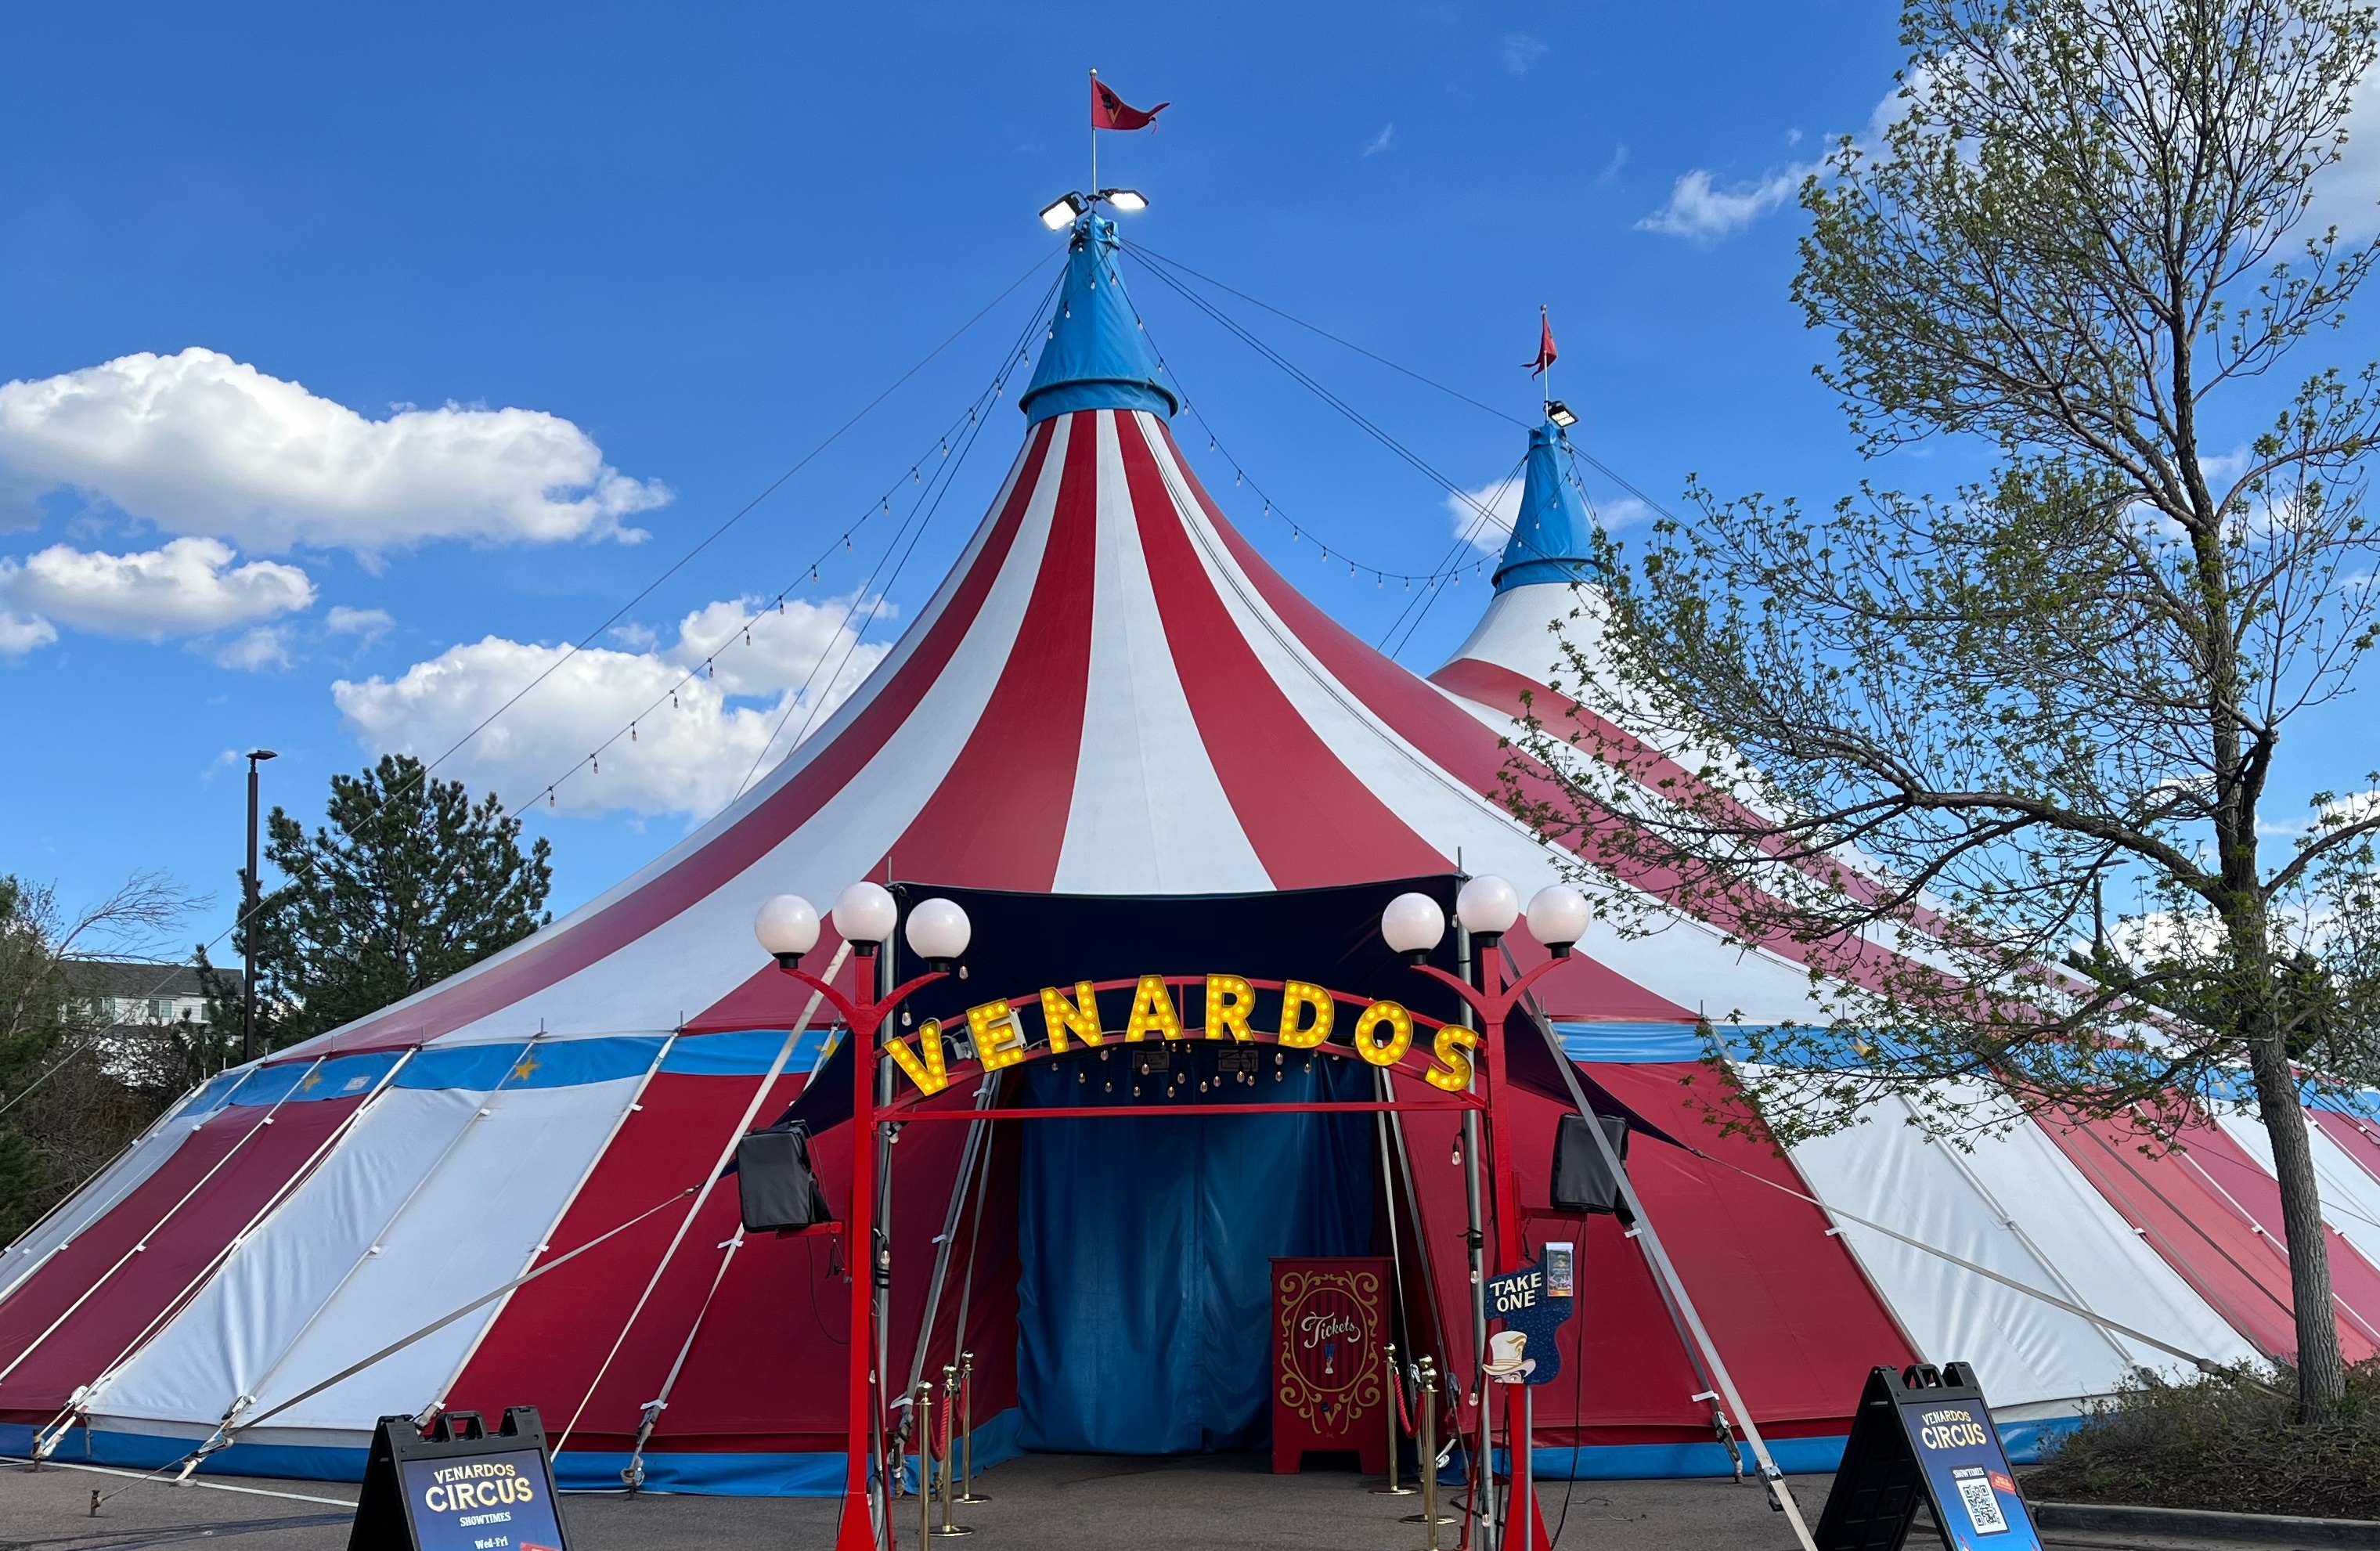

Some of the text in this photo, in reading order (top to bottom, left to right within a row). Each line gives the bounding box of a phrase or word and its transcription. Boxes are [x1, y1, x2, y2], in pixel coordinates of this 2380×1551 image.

[884, 973, 1479, 1096] VENARDOS
[1489, 1271, 1542, 1297] TAKE
[1496, 1289, 1536, 1312] ONE
[1300, 1311, 1361, 1349] Tickets
[1922, 1411, 1971, 1425] VENARDOS
[1921, 1423, 1986, 1449] CIRCUS
[434, 1464, 516, 1484] VENARDOS
[1953, 1467, 1984, 1478] SHOWTIMES
[425, 1477, 534, 1512] CIRCUS
[460, 1512, 511, 1527] SHOWTIMES
[474, 1535, 509, 1549] Wed-Fri
